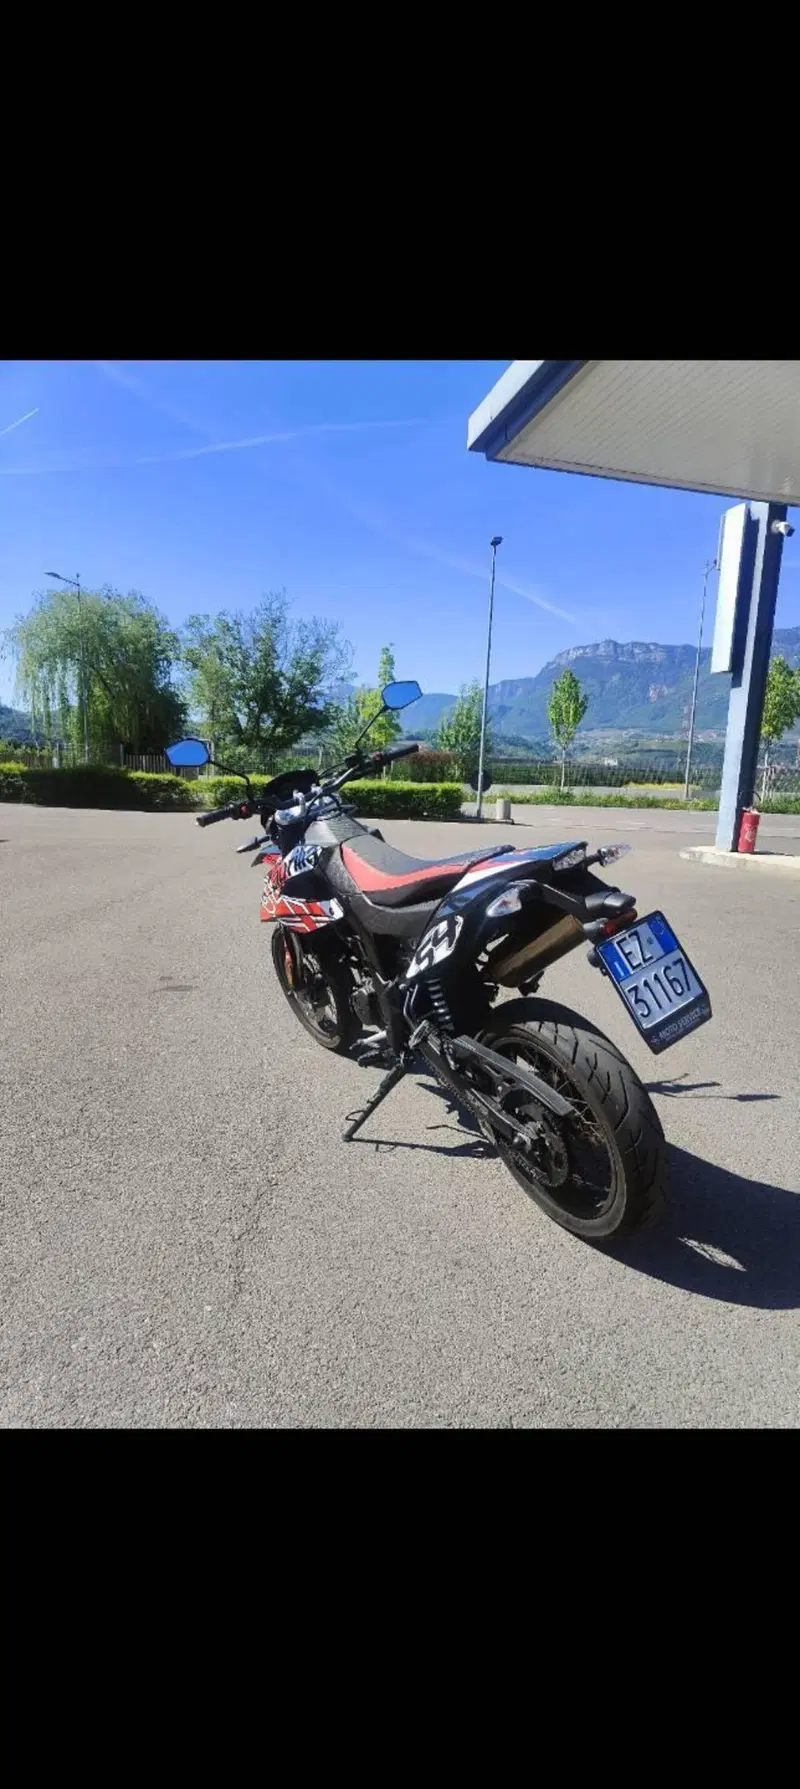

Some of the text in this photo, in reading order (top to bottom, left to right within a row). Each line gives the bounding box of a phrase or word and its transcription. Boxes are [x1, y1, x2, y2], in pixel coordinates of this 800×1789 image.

[415, 915, 460, 966] 54
[616, 930, 653, 970] EZ
[628, 958, 690, 1017] 31167
[659, 1022, 678, 1039] MOTO
